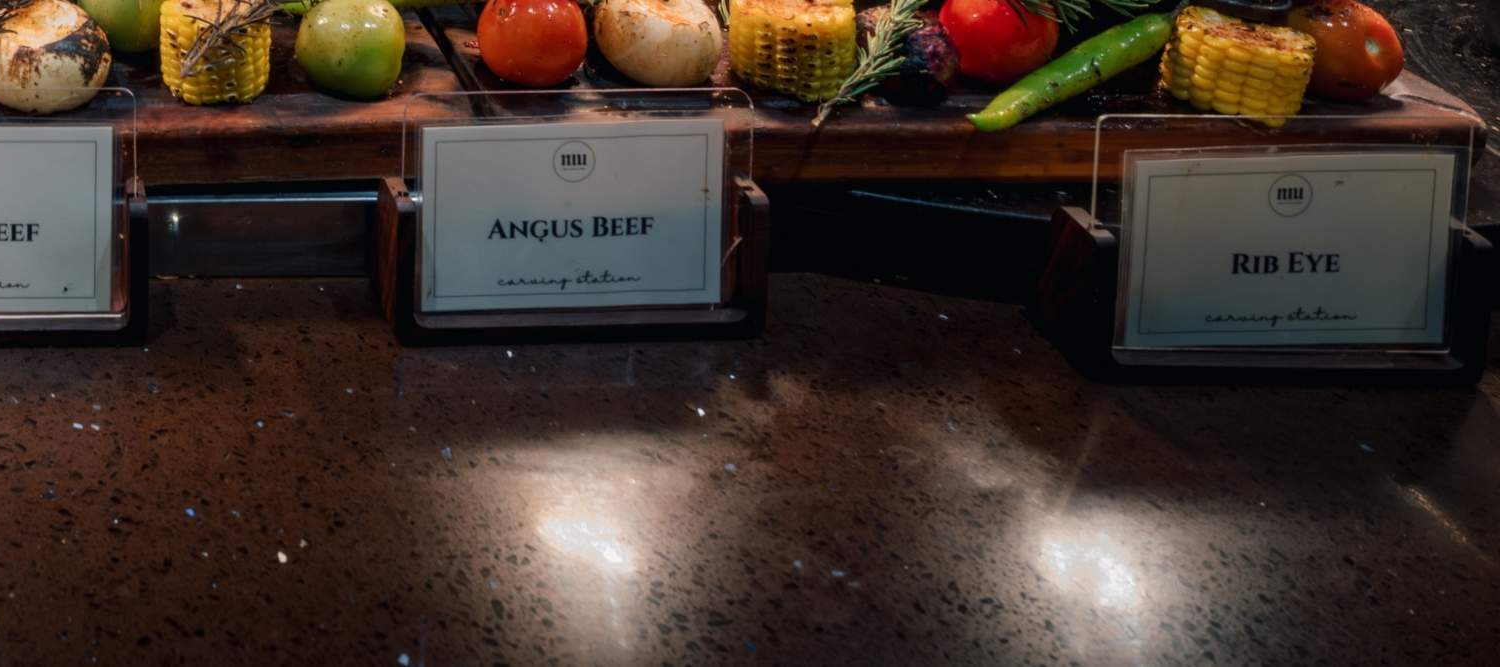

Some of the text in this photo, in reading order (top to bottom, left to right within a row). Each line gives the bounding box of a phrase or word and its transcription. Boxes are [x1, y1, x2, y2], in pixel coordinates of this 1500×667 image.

[487, 215, 655, 241] ANGUS BEEF
[1231, 252, 1341, 275] RIB EYE
[497, 269, 642, 291] carving station
[1205, 306, 1358, 327] carving station
